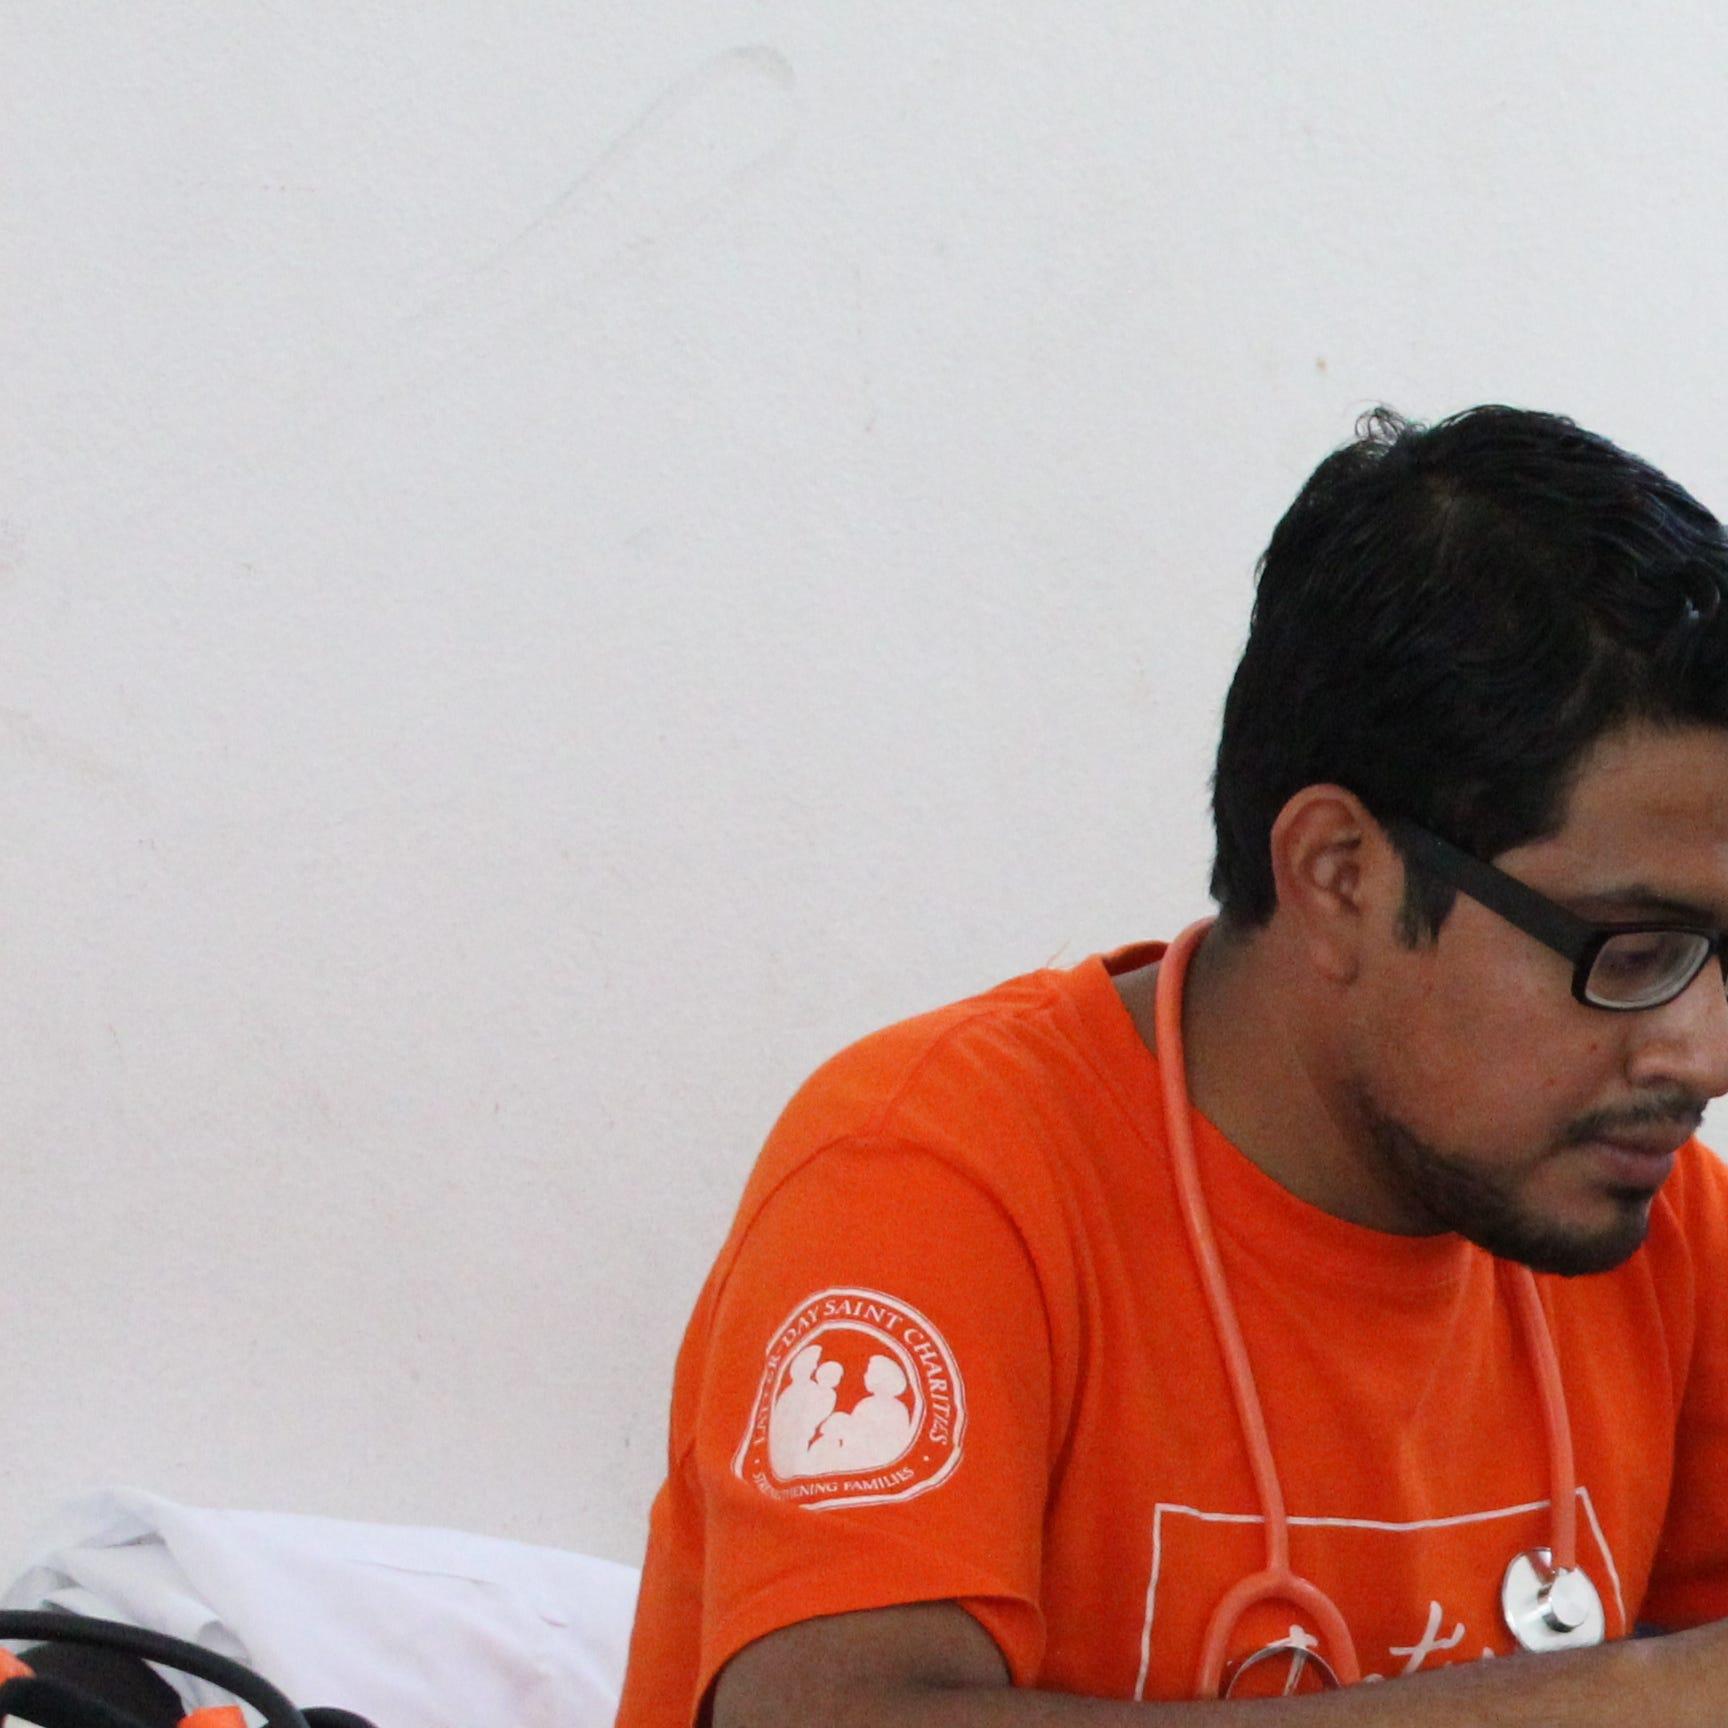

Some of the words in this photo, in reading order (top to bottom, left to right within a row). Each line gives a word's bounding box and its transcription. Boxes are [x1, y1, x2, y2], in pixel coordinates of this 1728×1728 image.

[822, 1299, 903, 1329] SAINT
[903, 1327, 951, 1446] CHARITIES
[843, 1466, 915, 1492] FAMILIES
